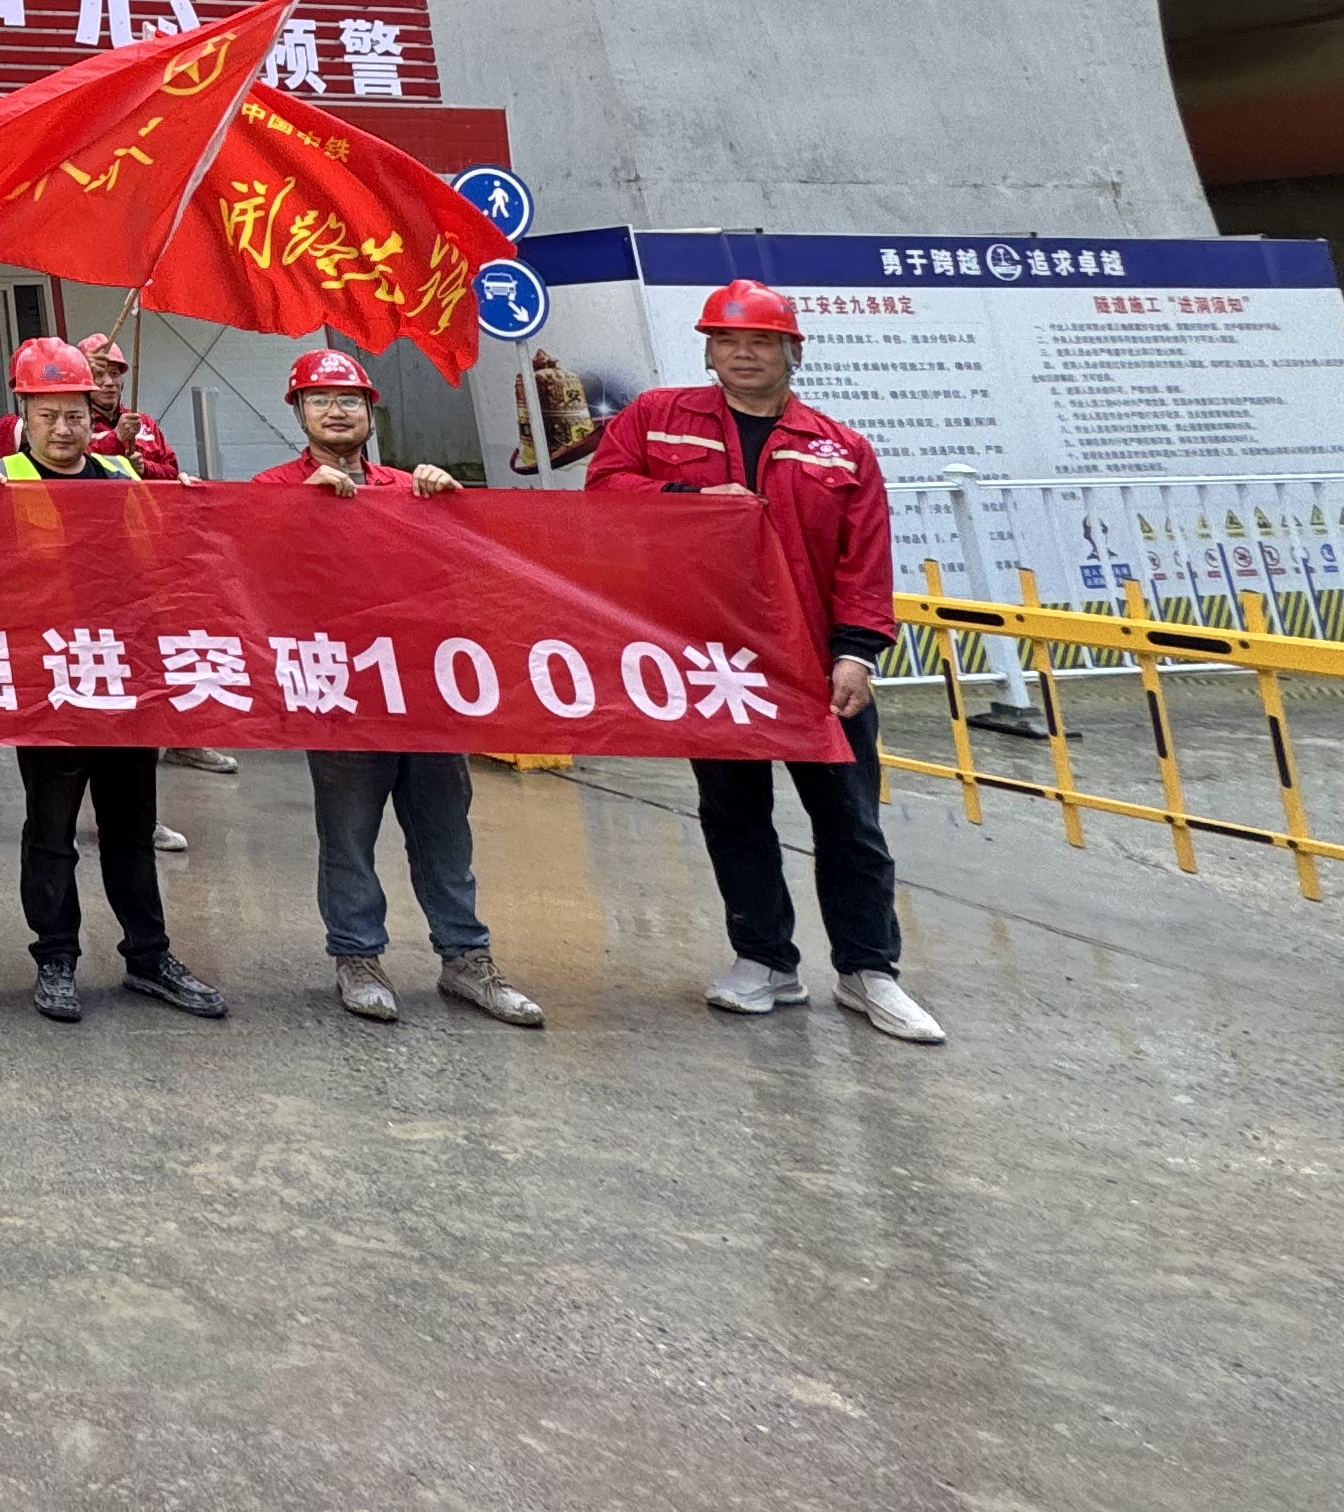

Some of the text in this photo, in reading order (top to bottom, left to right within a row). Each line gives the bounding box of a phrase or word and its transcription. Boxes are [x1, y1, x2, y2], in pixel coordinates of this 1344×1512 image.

[880, 248, 1126, 277] 勇于跨越 追求卓越
